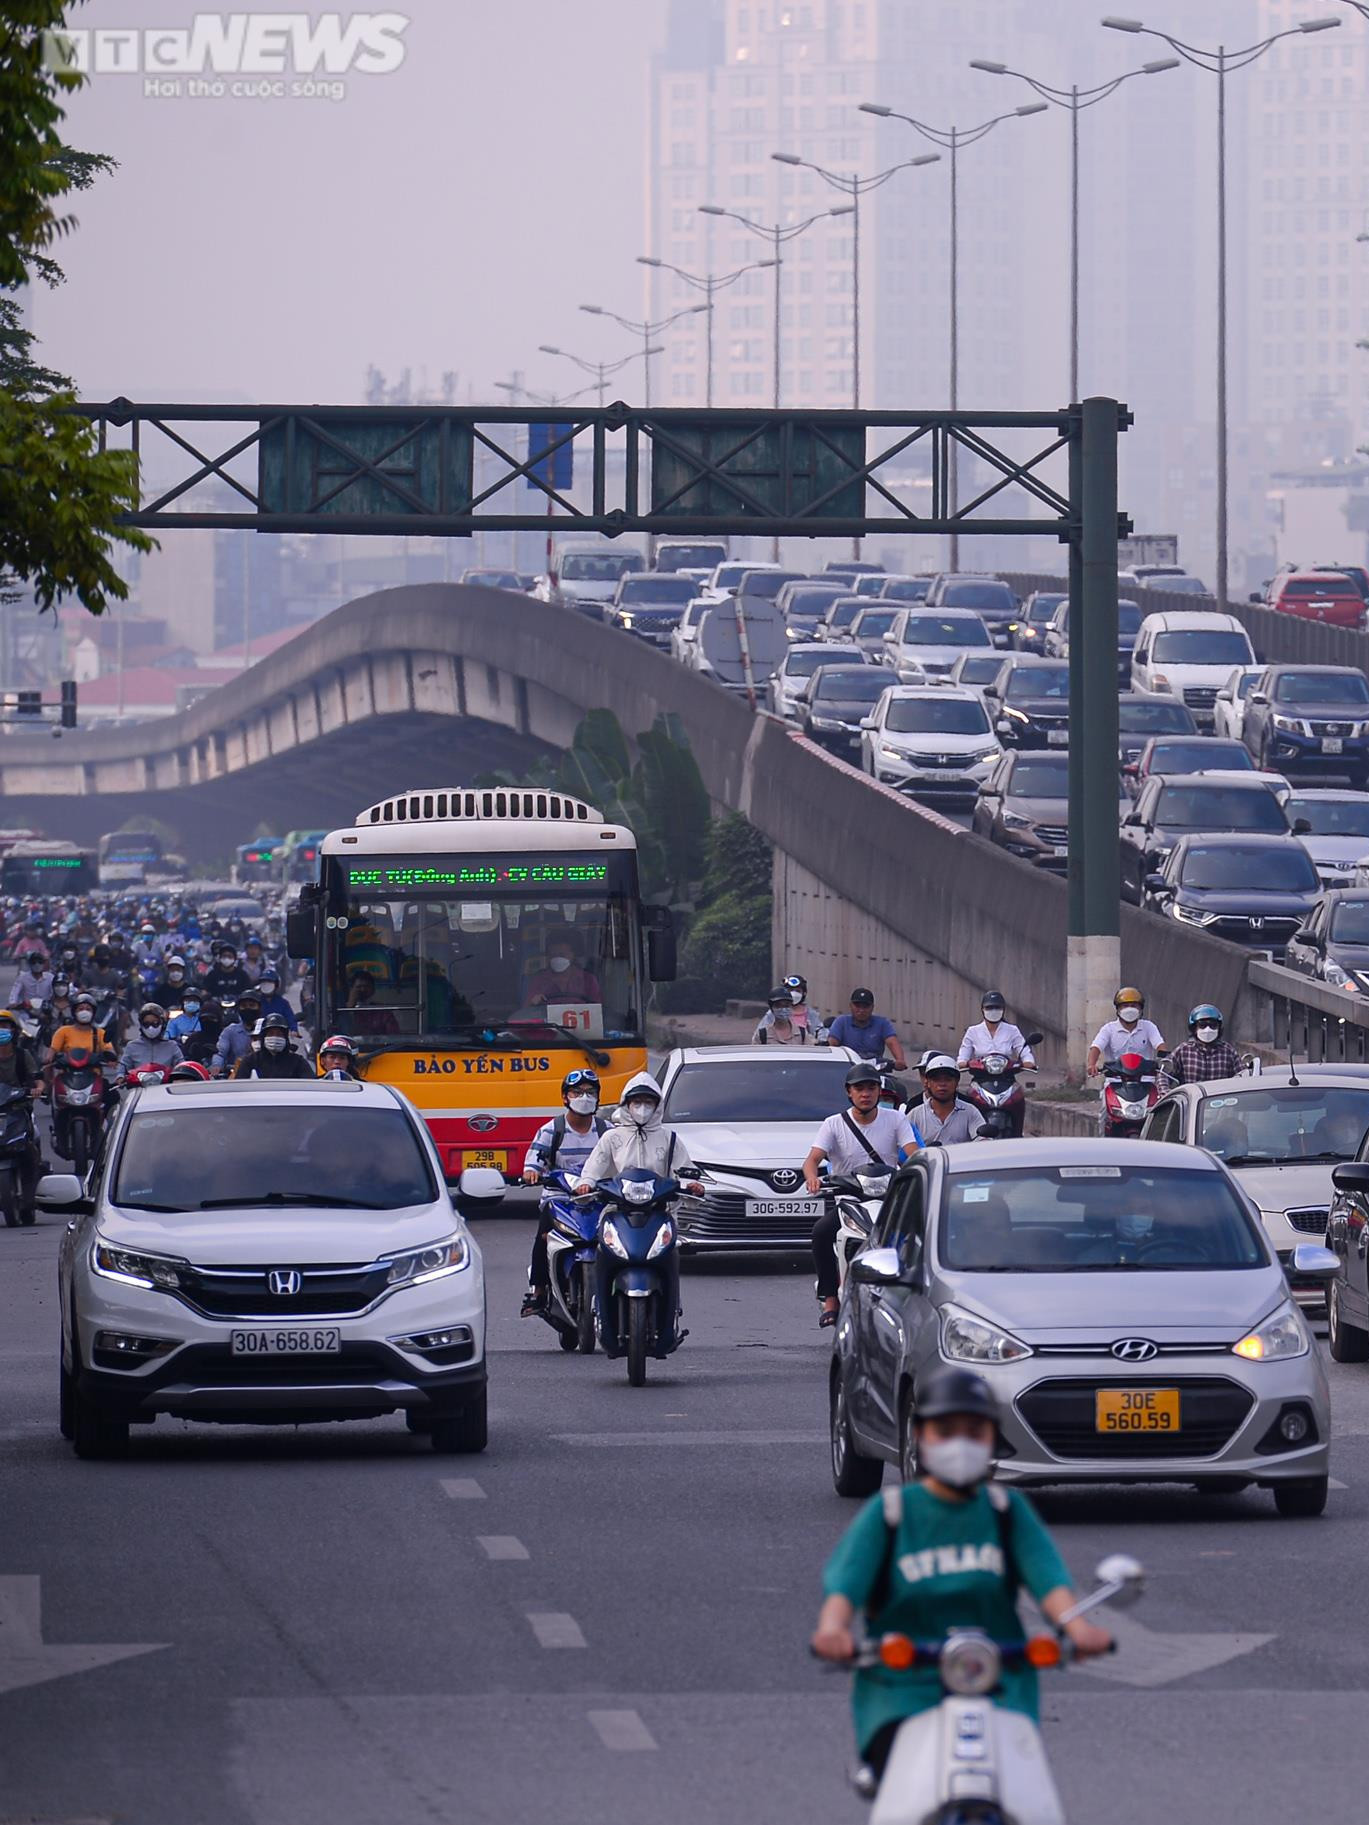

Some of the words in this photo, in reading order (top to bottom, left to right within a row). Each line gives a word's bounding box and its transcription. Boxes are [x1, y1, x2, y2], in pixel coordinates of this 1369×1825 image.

[562, 1010, 590, 1030] 61
[413, 1054, 456, 1074] BẢO
[461, 1053, 504, 1074] YẾN
[509, 1057, 550, 1073] BUS
[474, 1151, 495, 1161] 29B
[752, 1203, 818, 1214] 30G-592.97
[235, 1331, 337, 1353] 30A-658.62
[1121, 1392, 1156, 1410] 30E
[1106, 1411, 1171, 1430] 560.59
